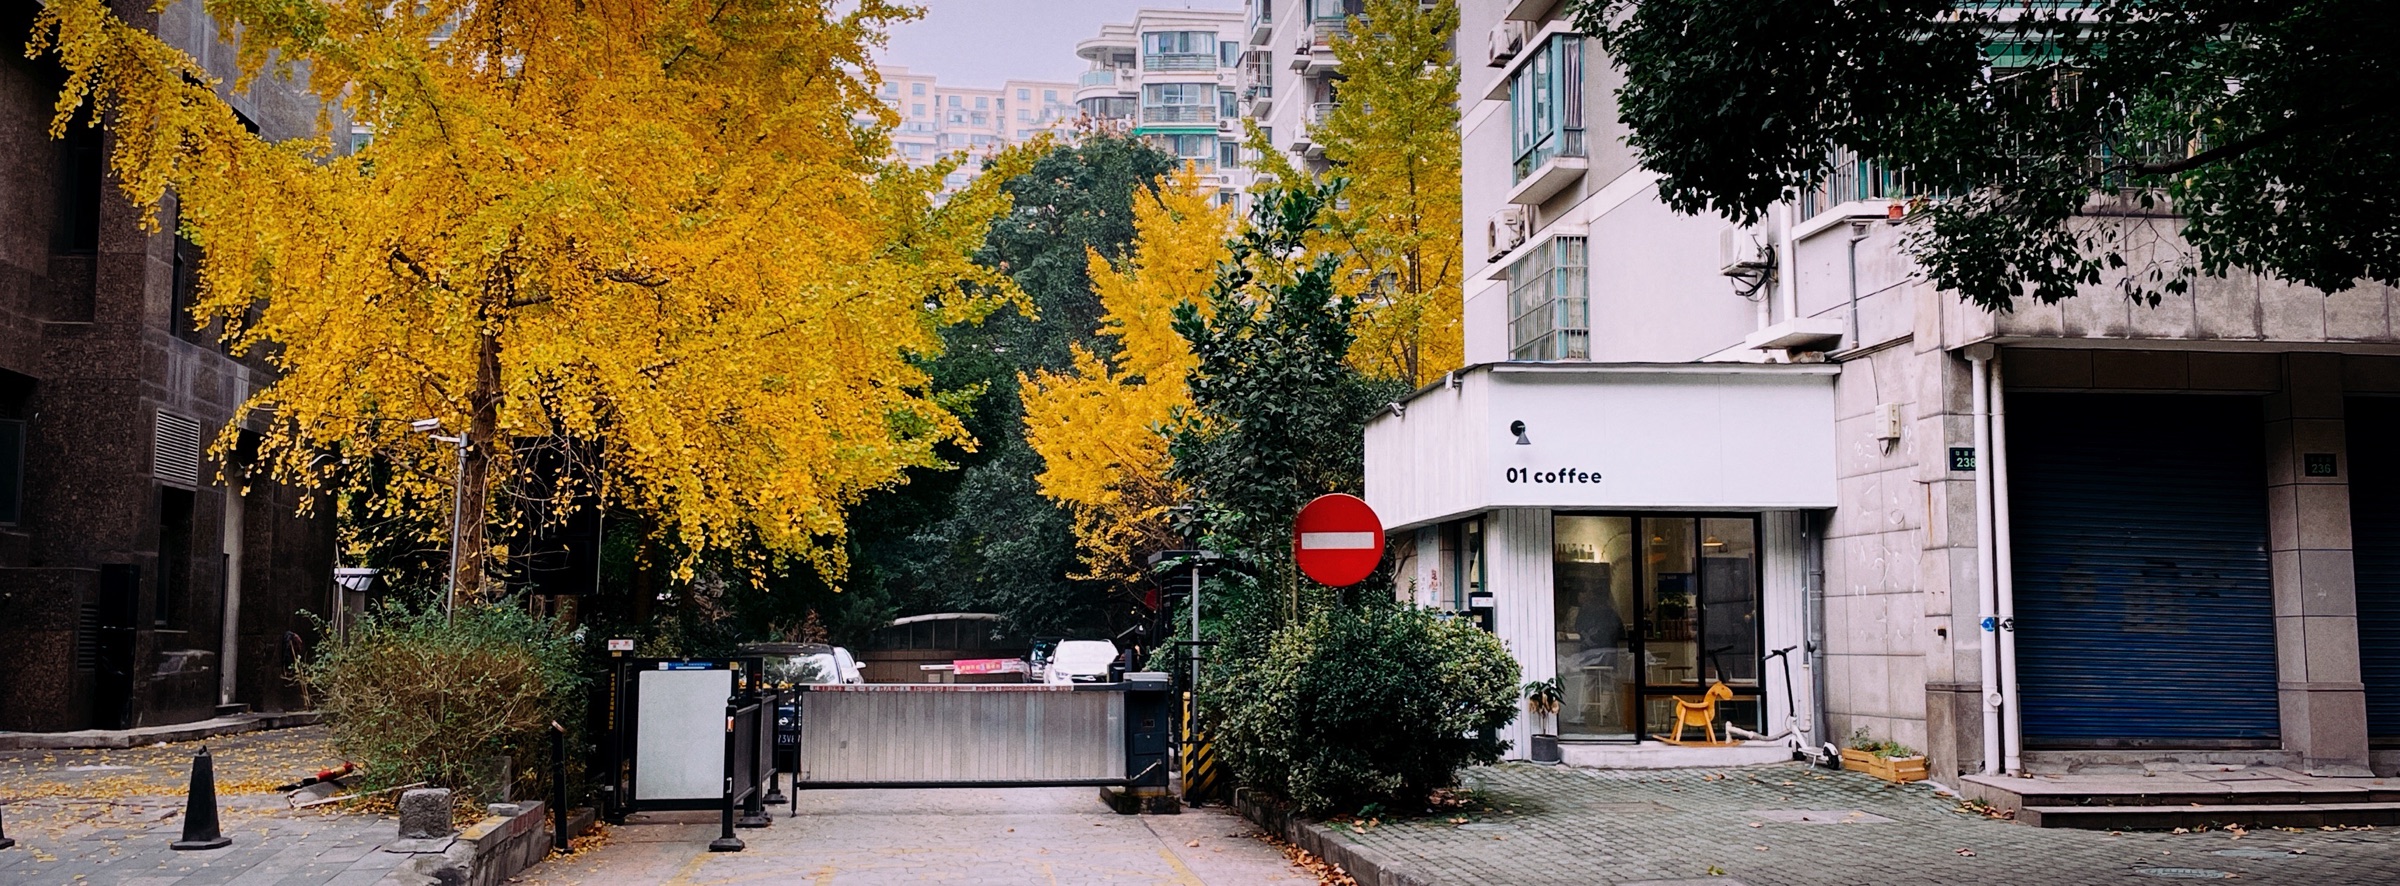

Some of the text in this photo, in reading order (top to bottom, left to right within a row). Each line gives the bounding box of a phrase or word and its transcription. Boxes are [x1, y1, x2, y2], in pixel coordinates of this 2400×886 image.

[1956, 457, 1976, 468] 238
[2311, 463, 2331, 474] 236
[1506, 467, 1602, 484] 01 coffee
